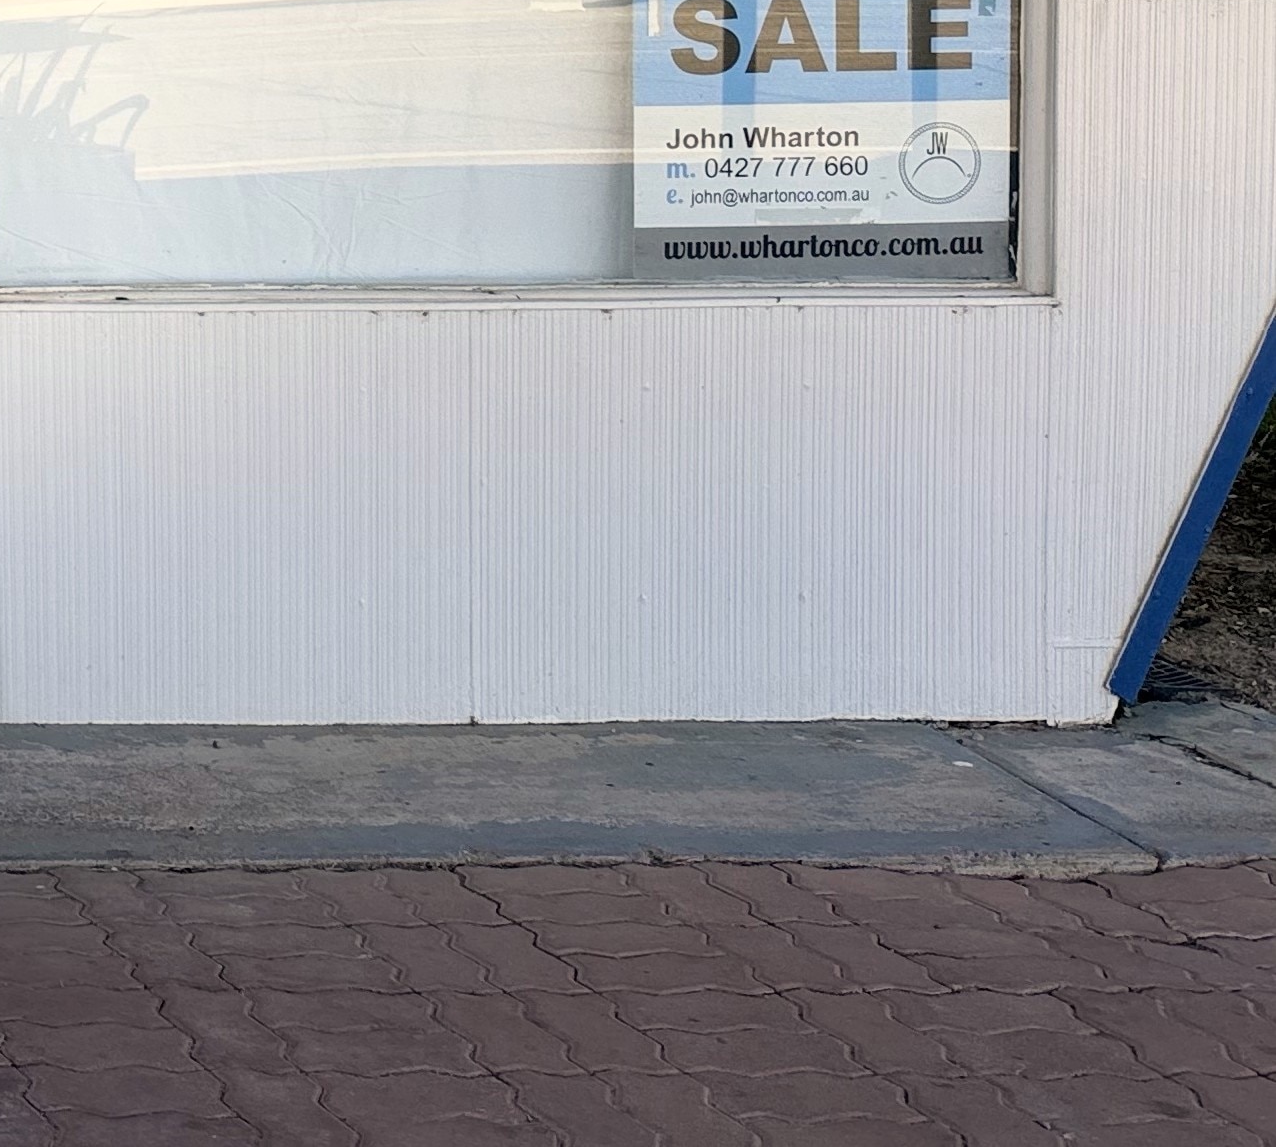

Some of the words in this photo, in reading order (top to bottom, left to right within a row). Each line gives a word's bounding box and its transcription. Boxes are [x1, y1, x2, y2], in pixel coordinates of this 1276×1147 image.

[666, 128, 734, 150] John
[743, 126, 860, 149] Wharton
[666, 160, 696, 179] m.
[704, 157, 763, 179] 0427
[773, 156, 817, 178] 777
[824, 155, 868, 177] 660
[666, 188, 684, 205] e.
[689, 186, 870, 208] john@whartonco.com.au
[663, 234, 984, 260] www.whartonco.com.au
